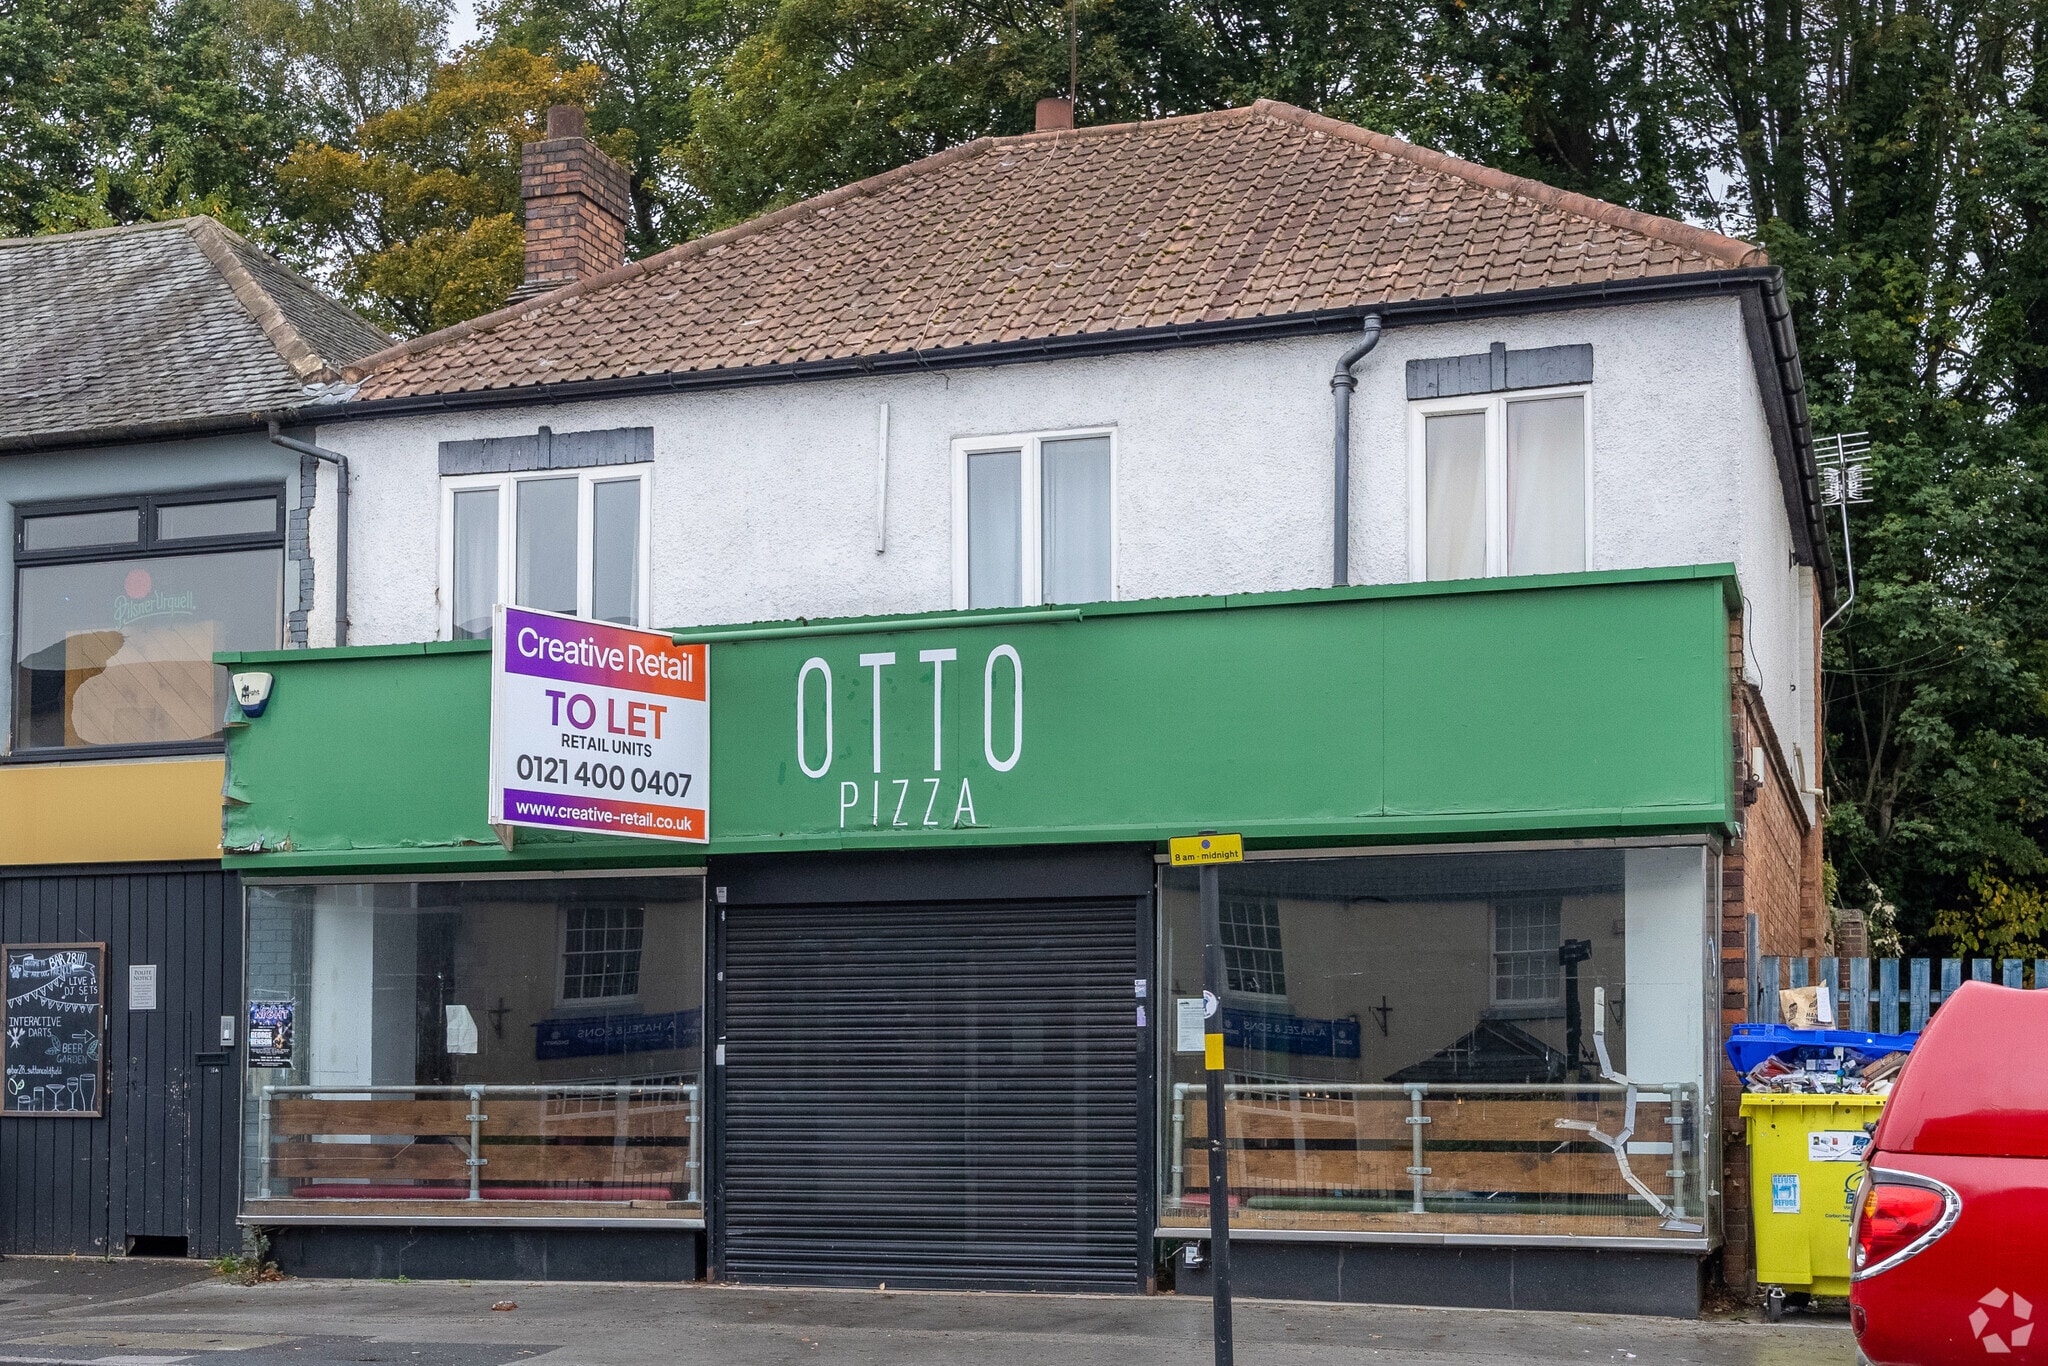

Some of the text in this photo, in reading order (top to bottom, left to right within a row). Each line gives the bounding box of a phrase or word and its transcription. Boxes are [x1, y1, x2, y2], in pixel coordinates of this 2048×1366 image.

[113, 594, 155, 630] Pilsner
[517, 627, 693, 682] Creative Retail
[545, 689, 668, 740] TO LET
[797, 643, 1022, 778] OTTO
[561, 733, 652, 758] RETAIL UNITS
[516, 754, 692, 798] 0121 400 0407
[840, 777, 976, 828] PIZZA
[515, 801, 692, 832] www.creative-retail.co.uk
[1175, 853, 1181, 861] 8
[1201, 850, 1239, 860] midnight
[48, 953, 66, 970] BAR
[64, 986, 98, 996] DJ SETS
[69, 976, 87, 986] LIVE
[8, 1016, 62, 1027] INTERACTIVE
[28, 1027, 52, 1038] DARTS
[56, 1053, 88, 1064] GARDEN
[62, 1043, 83, 1054] BEER
